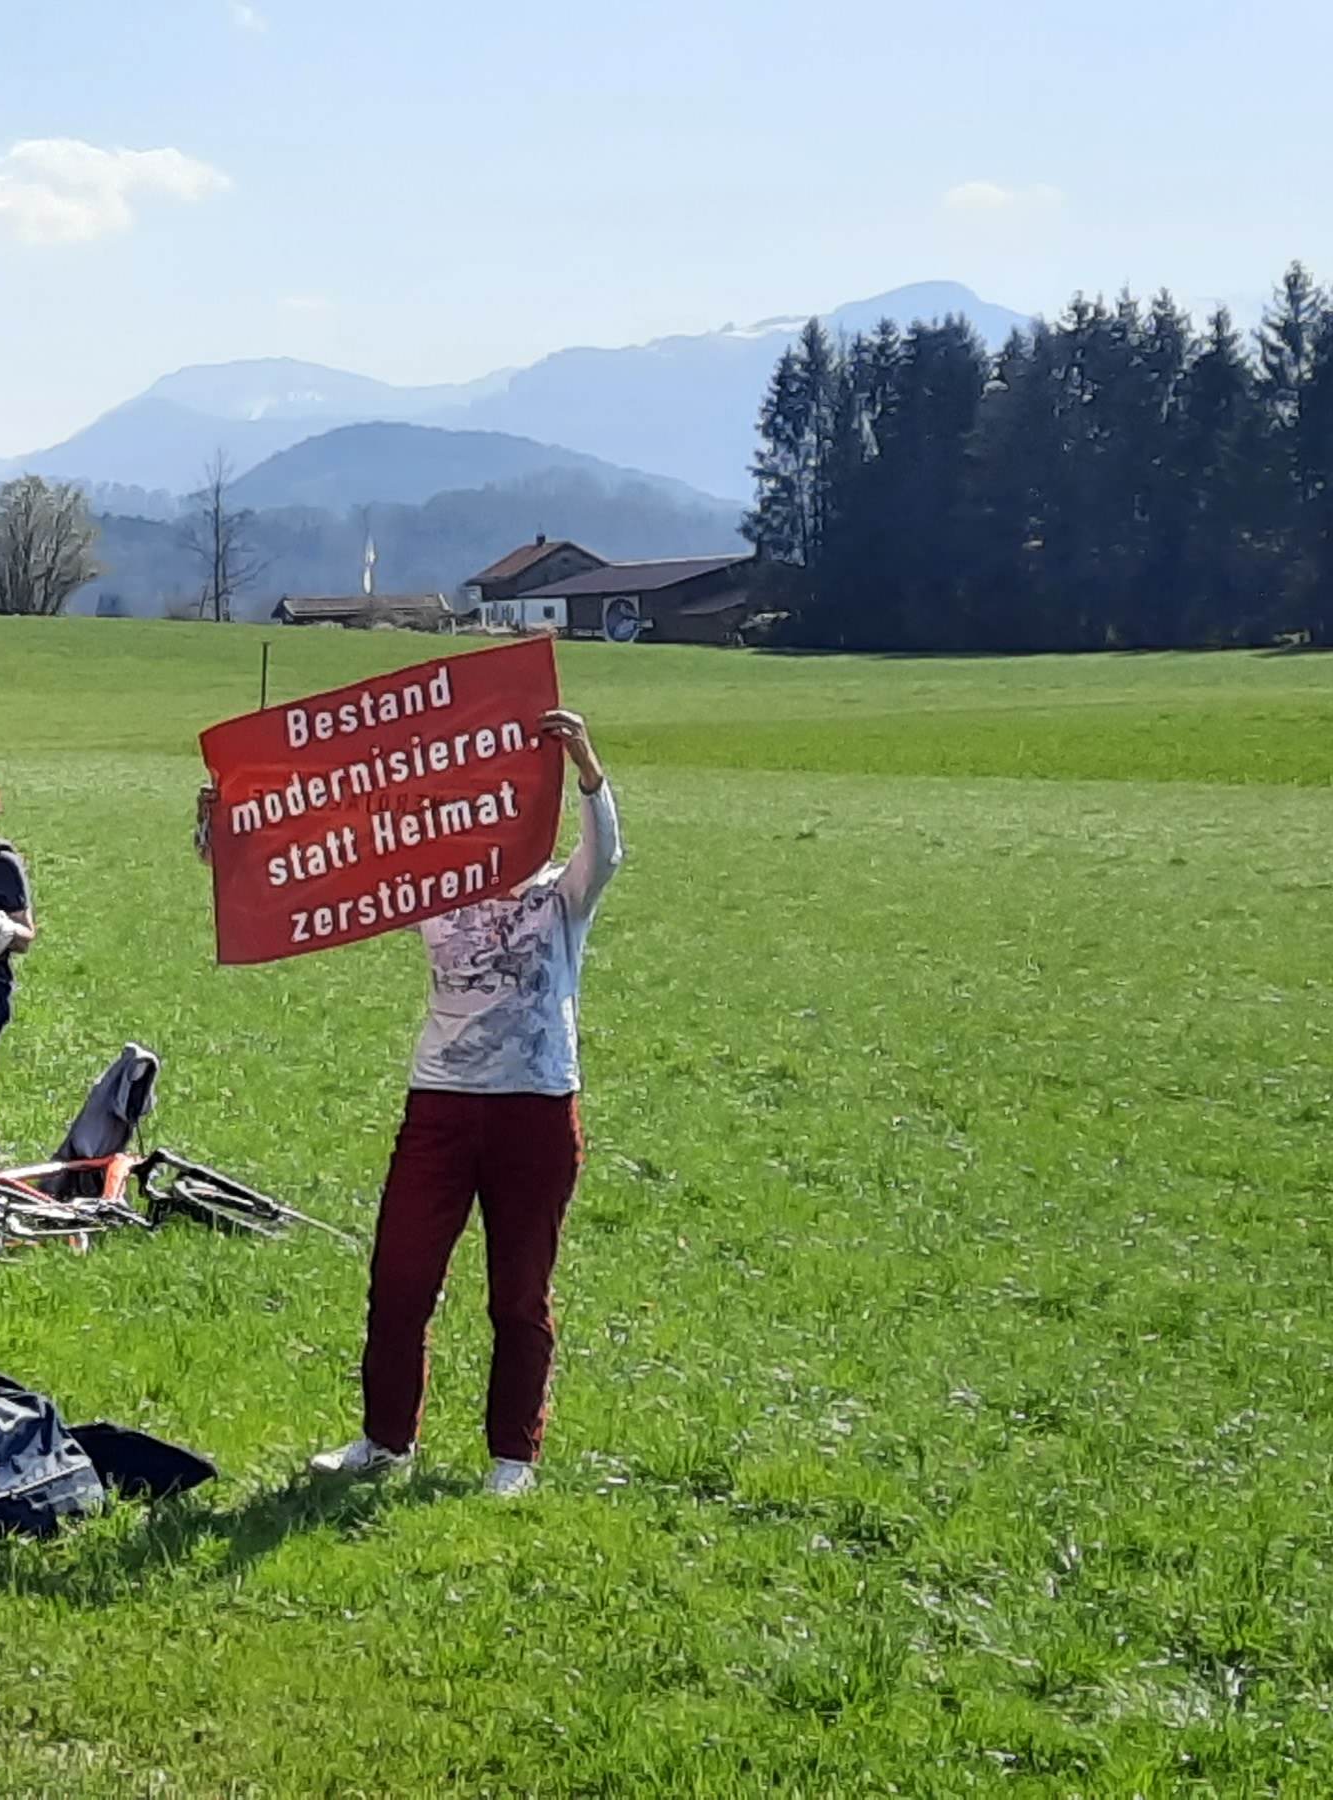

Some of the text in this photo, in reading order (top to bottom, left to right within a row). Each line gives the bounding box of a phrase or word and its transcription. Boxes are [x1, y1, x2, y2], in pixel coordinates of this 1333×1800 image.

[287, 666, 451, 748] Bestand
[268, 781, 519, 886] statt Heimat
[291, 847, 502, 943] zerstören!
